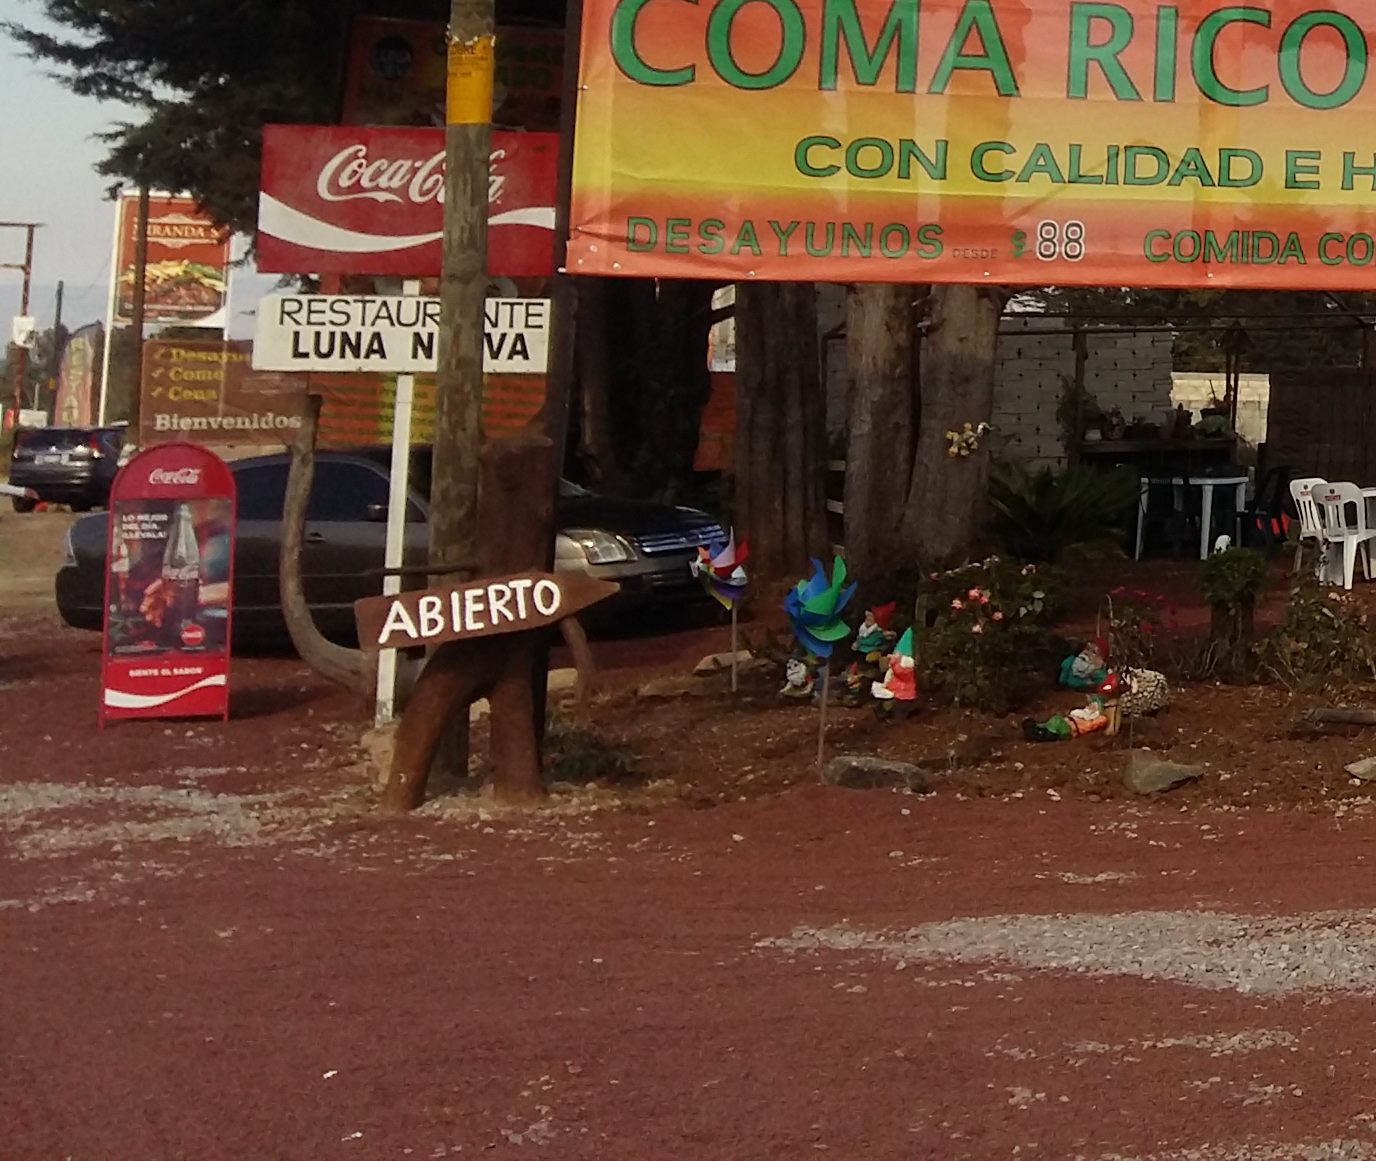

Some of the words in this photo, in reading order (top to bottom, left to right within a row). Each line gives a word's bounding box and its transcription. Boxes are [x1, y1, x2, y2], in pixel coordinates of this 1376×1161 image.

[1066, 0, 1369, 110] RICO
[794, 136, 948, 180] CON
[970, 141, 1264, 190] CALIDAD
[1284, 149, 1321, 190] E
[627, 216, 944, 259] DESAYUNOS
[1143, 229, 1306, 266] COMIDA
[279, 299, 544, 329] RESTAURNTE
[291, 330, 387, 359] LUNA
[411, 331, 530, 360] NVA
[153, 413, 301, 431] Bienvenidos
[378, 579, 562, 644] ABIERTO
